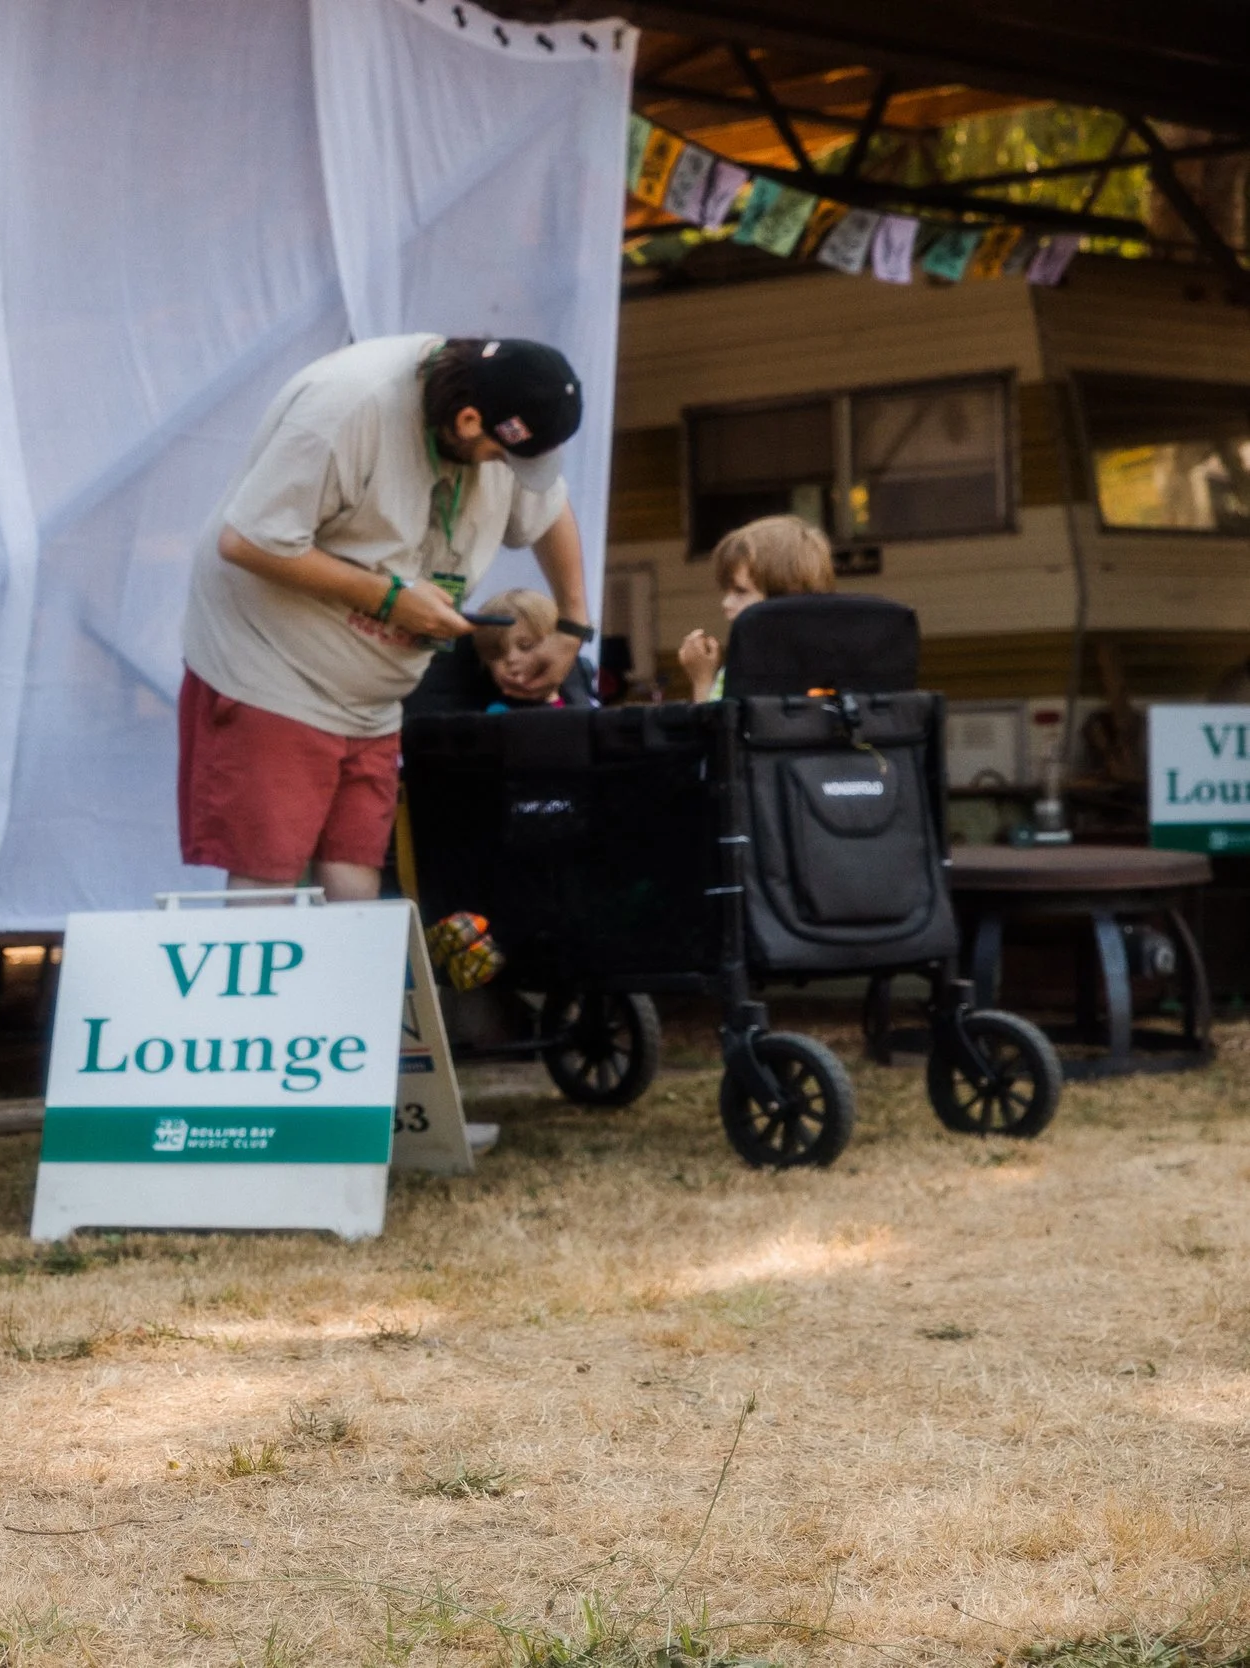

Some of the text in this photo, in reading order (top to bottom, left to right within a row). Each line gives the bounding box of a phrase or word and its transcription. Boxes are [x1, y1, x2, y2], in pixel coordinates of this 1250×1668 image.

[1203, 723, 1250, 760] VI
[159, 940, 304, 998] VIP
[77, 1017, 367, 1093] Lounge
[187, 1138, 268, 1149] MUSIC CLUB
